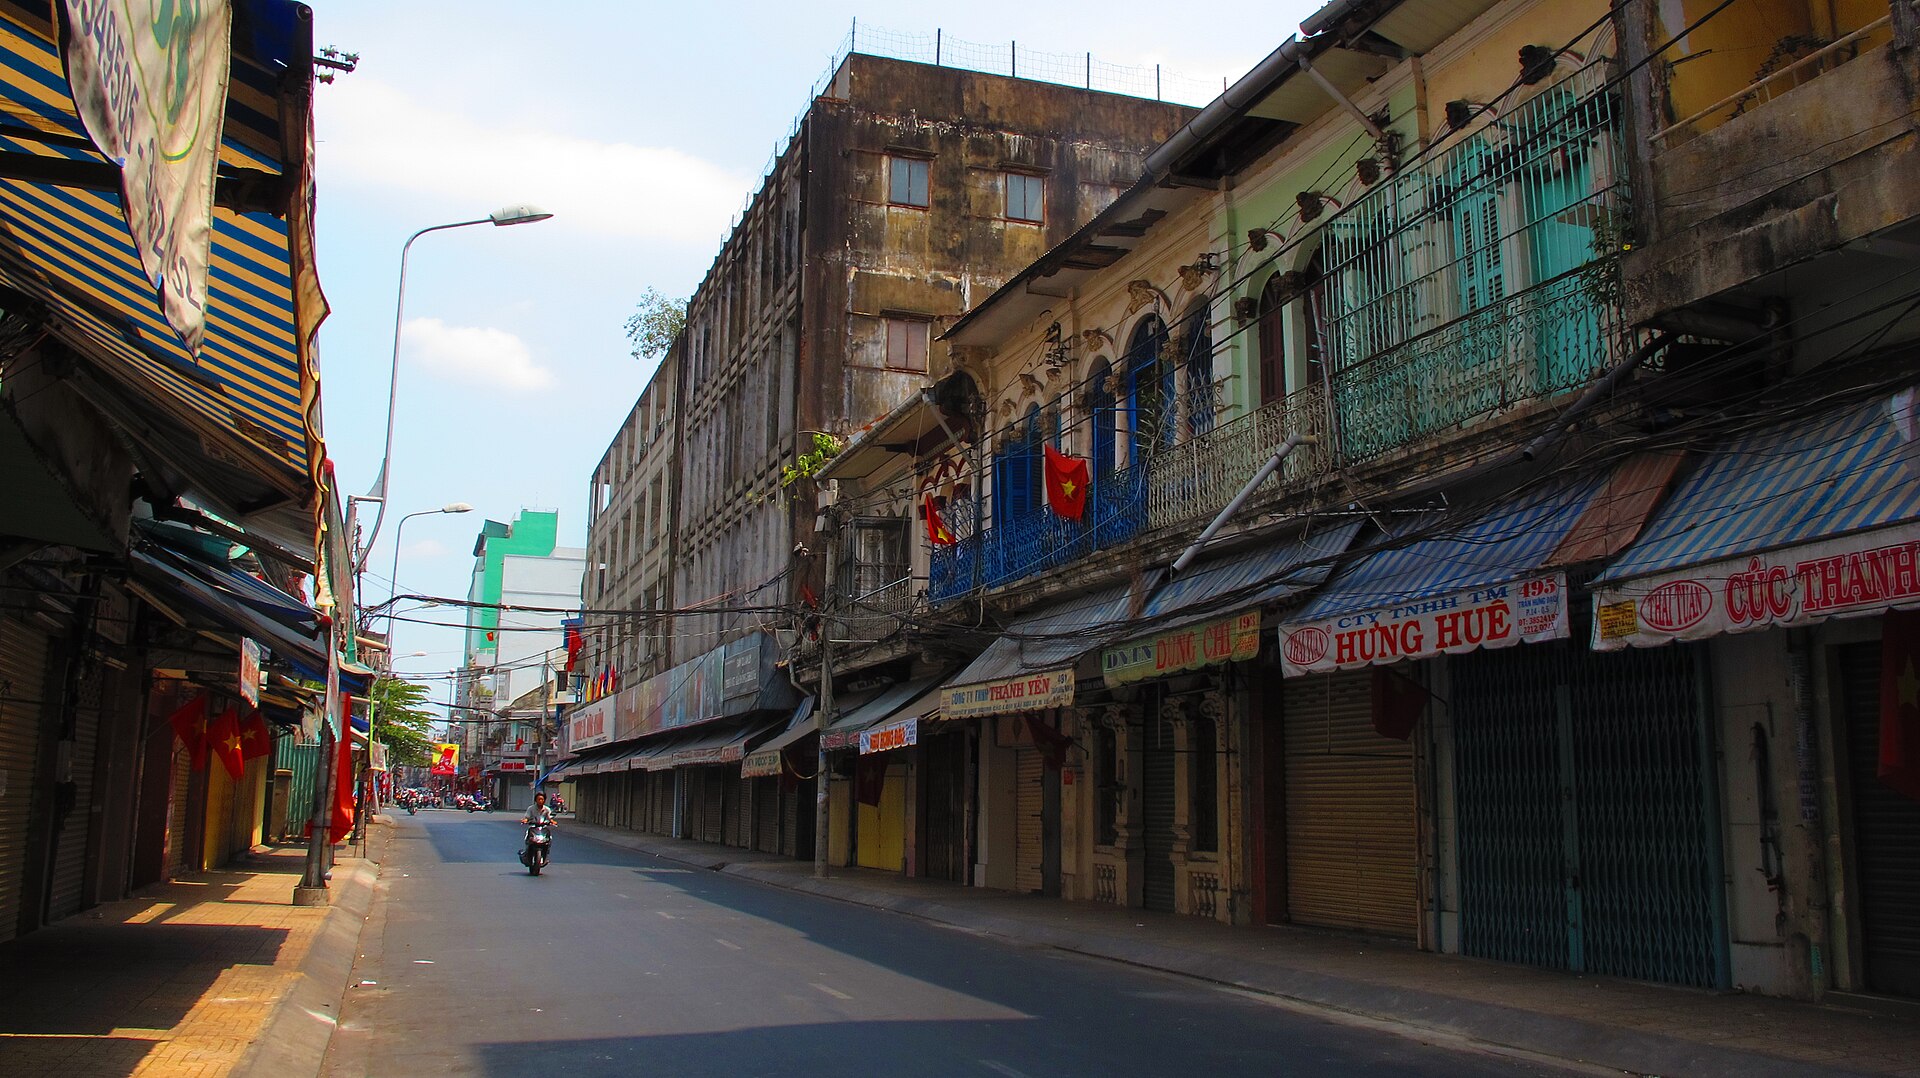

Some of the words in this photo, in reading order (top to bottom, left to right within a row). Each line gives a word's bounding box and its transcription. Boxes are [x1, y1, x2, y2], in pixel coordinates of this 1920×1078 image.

[1518, 578, 1556, 598] 495
[1725, 557, 1792, 623] CÚC
[1797, 541, 1920, 612] THANH
[1337, 611, 1379, 629] CTY
[1390, 598, 1459, 619] TNHH
[1468, 585, 1510, 604] TM
